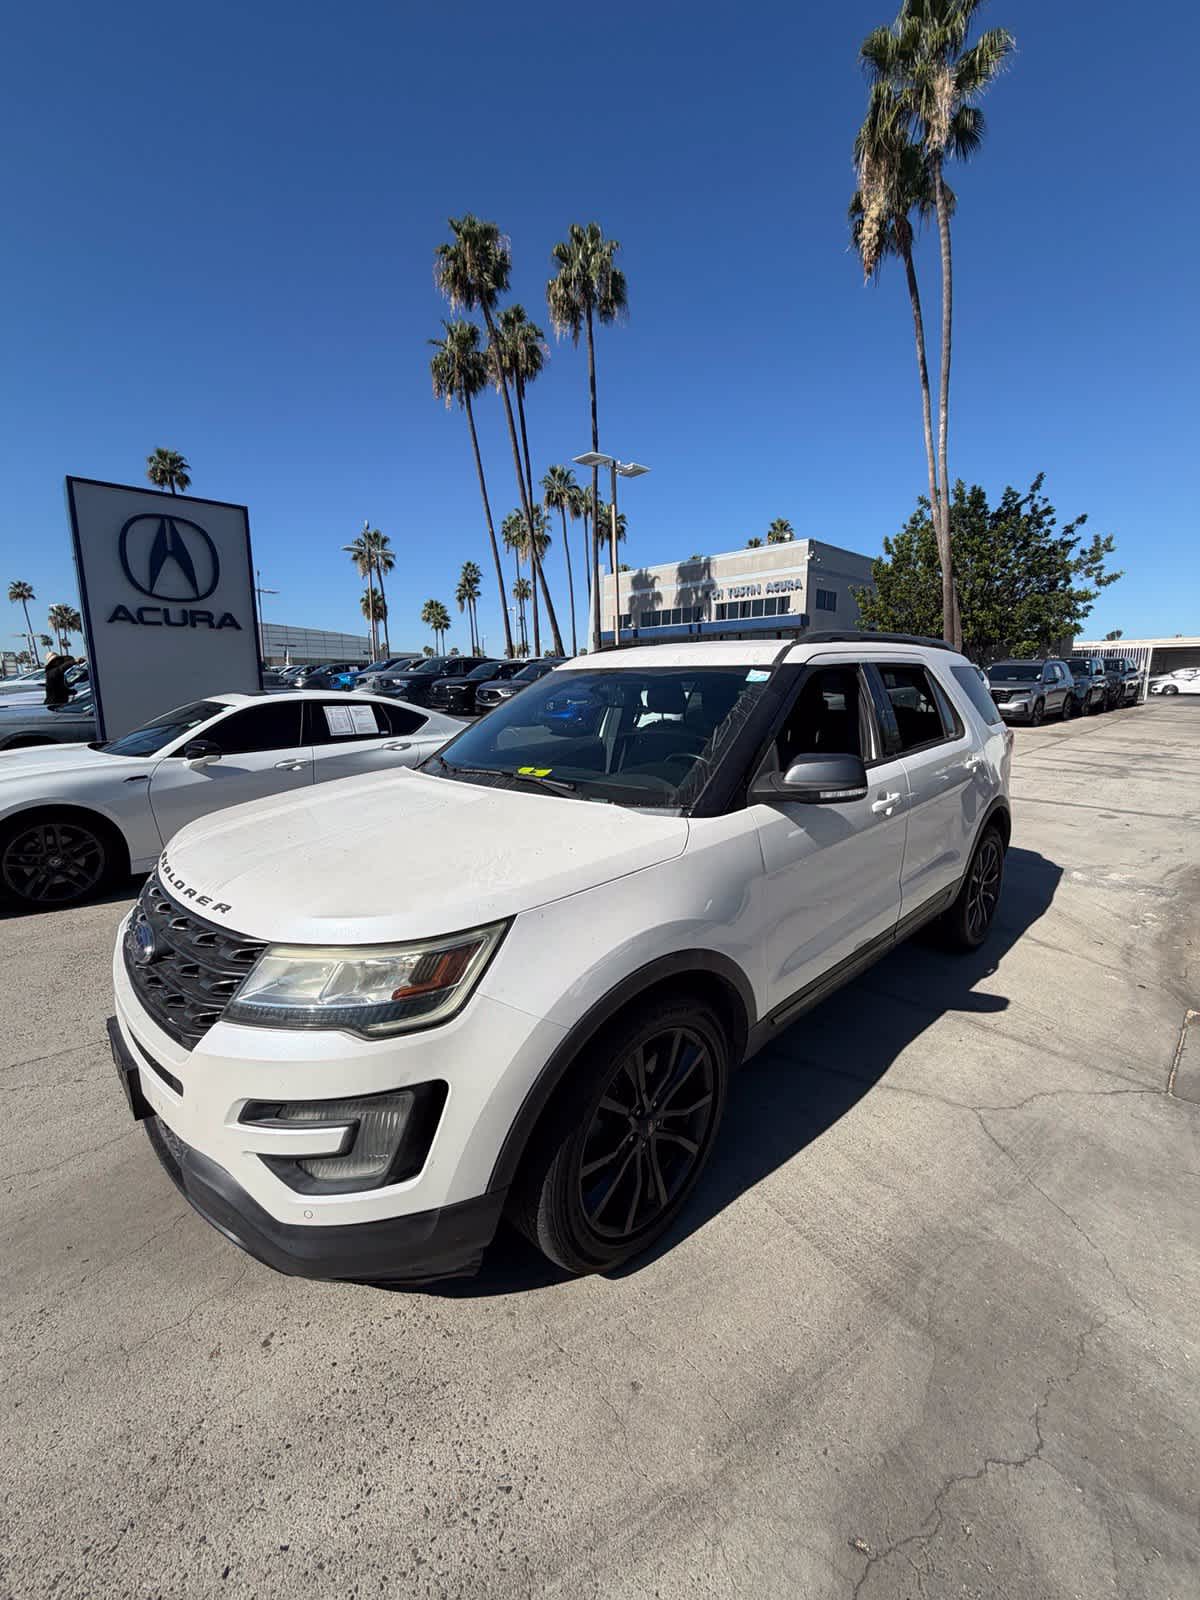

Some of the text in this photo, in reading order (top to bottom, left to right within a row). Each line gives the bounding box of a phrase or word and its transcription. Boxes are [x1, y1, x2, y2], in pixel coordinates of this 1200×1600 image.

[728, 584, 761, 599] TUSTIN
[765, 579, 802, 594] ACURA
[107, 604, 242, 631] ACURA
